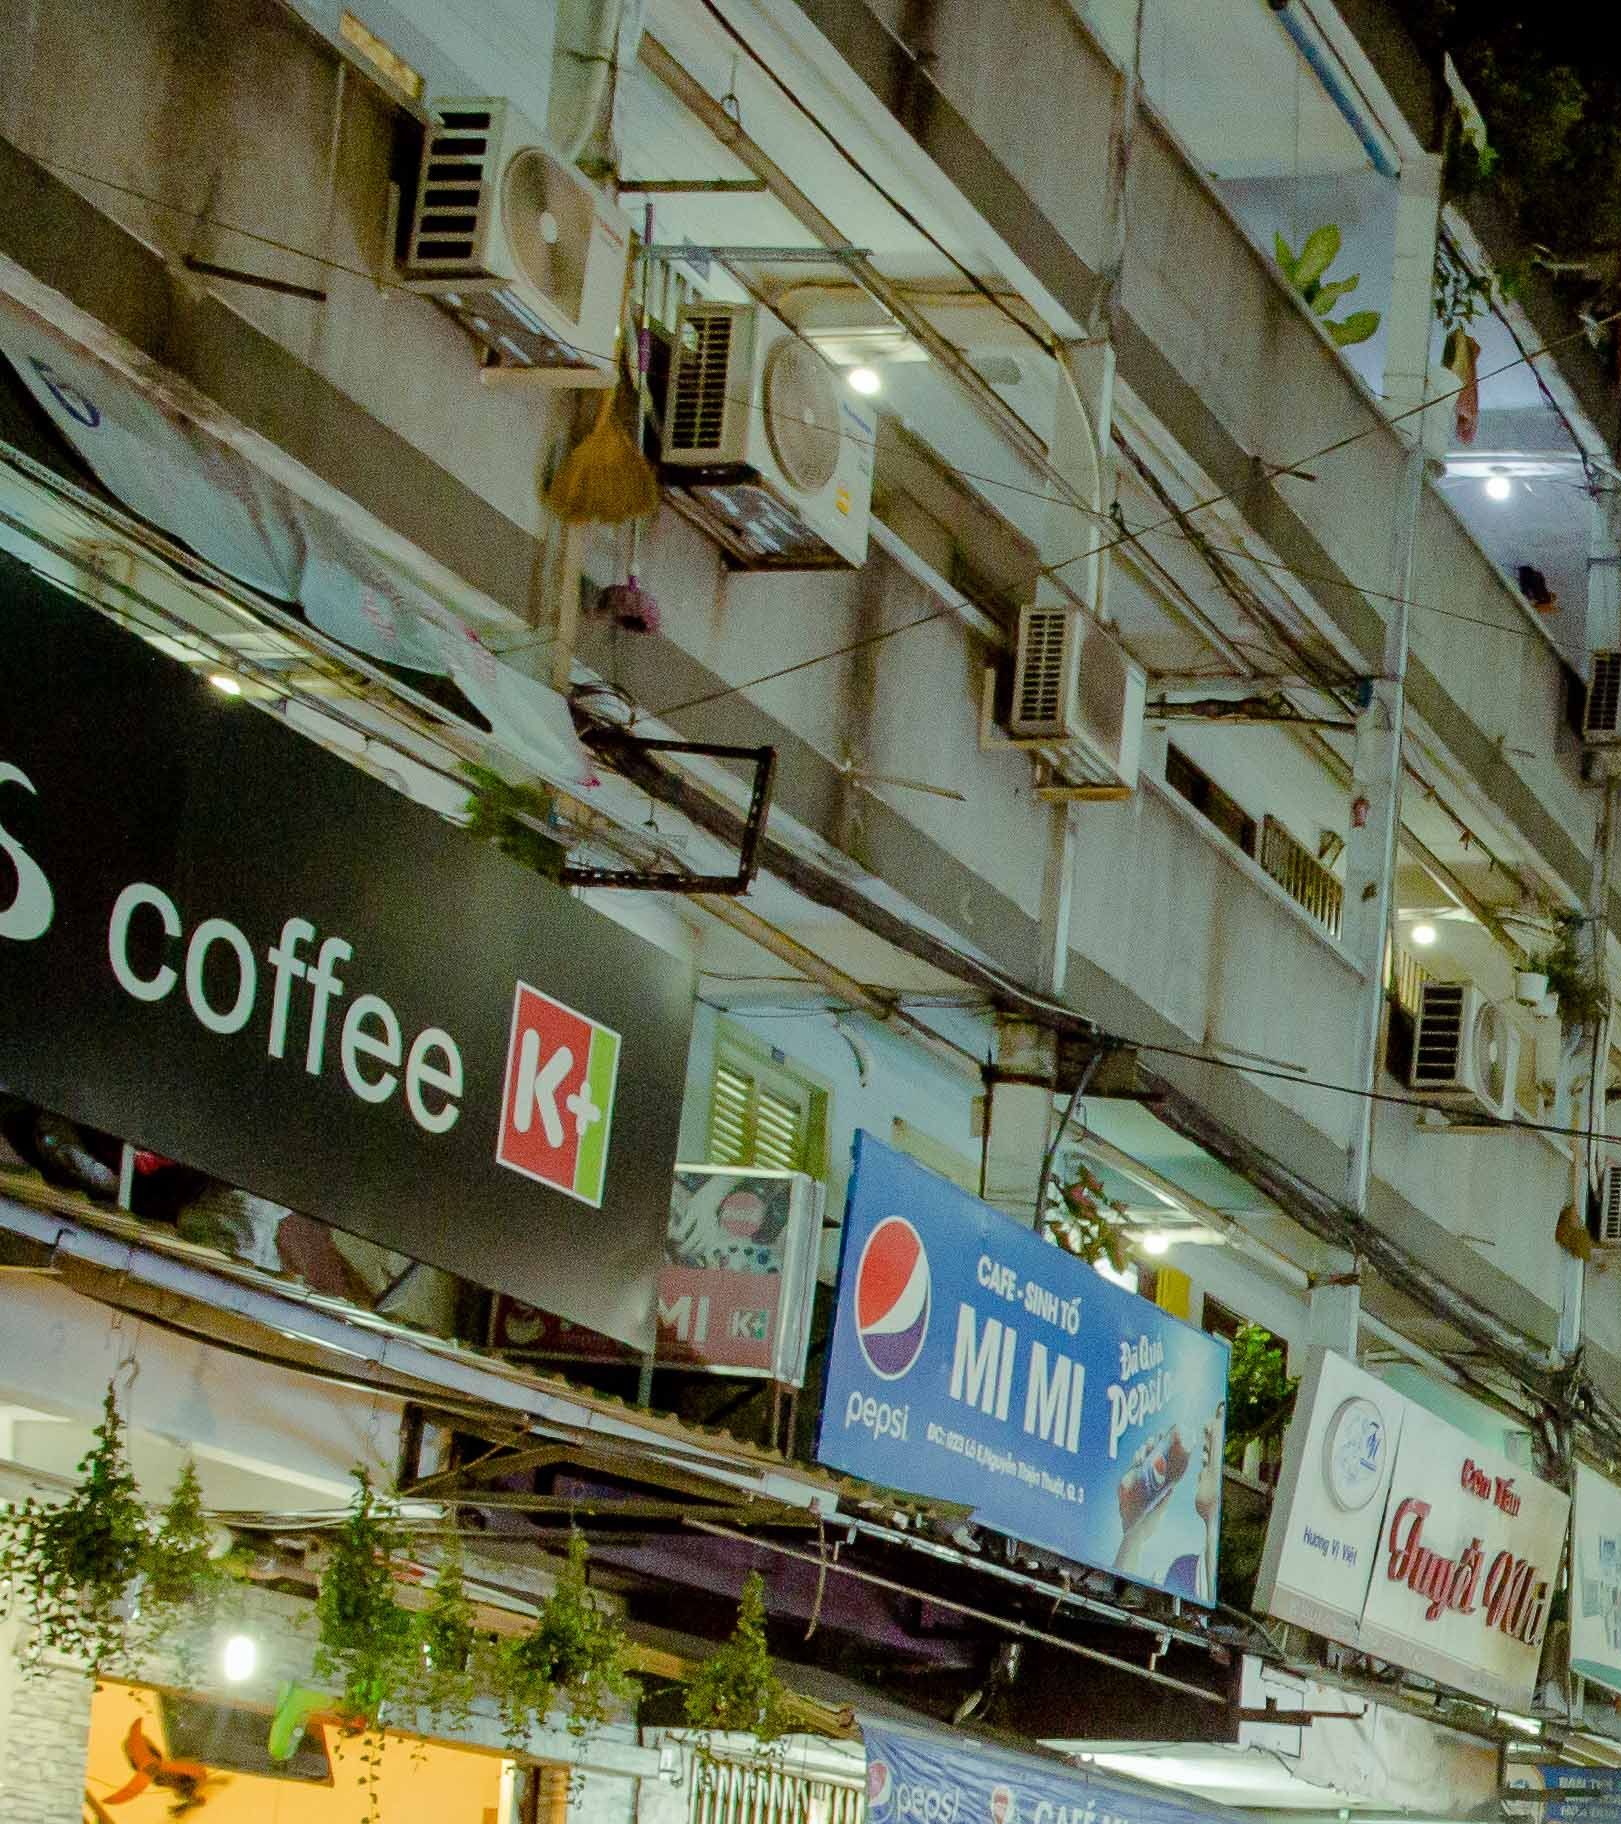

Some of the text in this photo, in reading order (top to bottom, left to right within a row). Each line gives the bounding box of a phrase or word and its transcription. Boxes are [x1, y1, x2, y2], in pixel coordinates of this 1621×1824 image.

[108, 882, 464, 1134] coffee
[515, 1029, 602, 1149] K+
[977, 1255, 1081, 1335] CAFE SINH TỐ
[845, 1391, 909, 1440] pepsi
[950, 1303, 1085, 1454] MI MI
